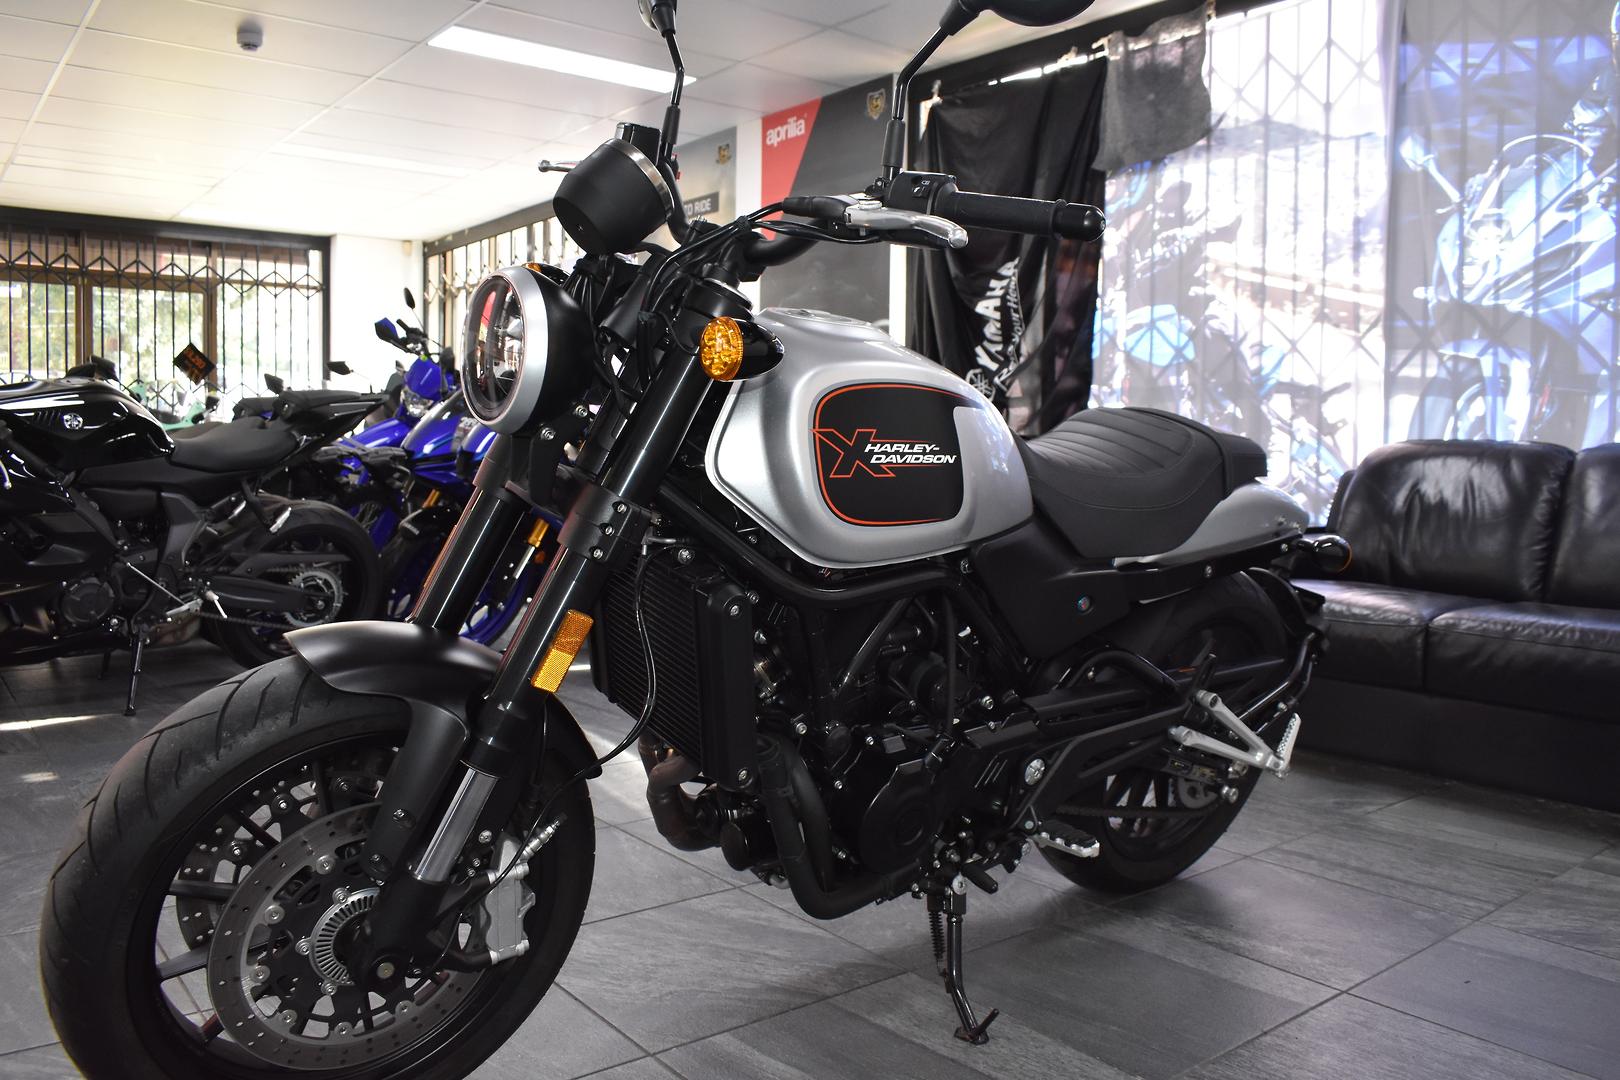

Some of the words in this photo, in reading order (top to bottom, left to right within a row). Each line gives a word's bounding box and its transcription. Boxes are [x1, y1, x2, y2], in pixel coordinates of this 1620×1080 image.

[766, 116, 806, 147] aprilia
[694, 198, 712, 214] RIDE
[864, 443, 940, 453] HARLEY-
[870, 454, 957, 464] DAVIDSON
